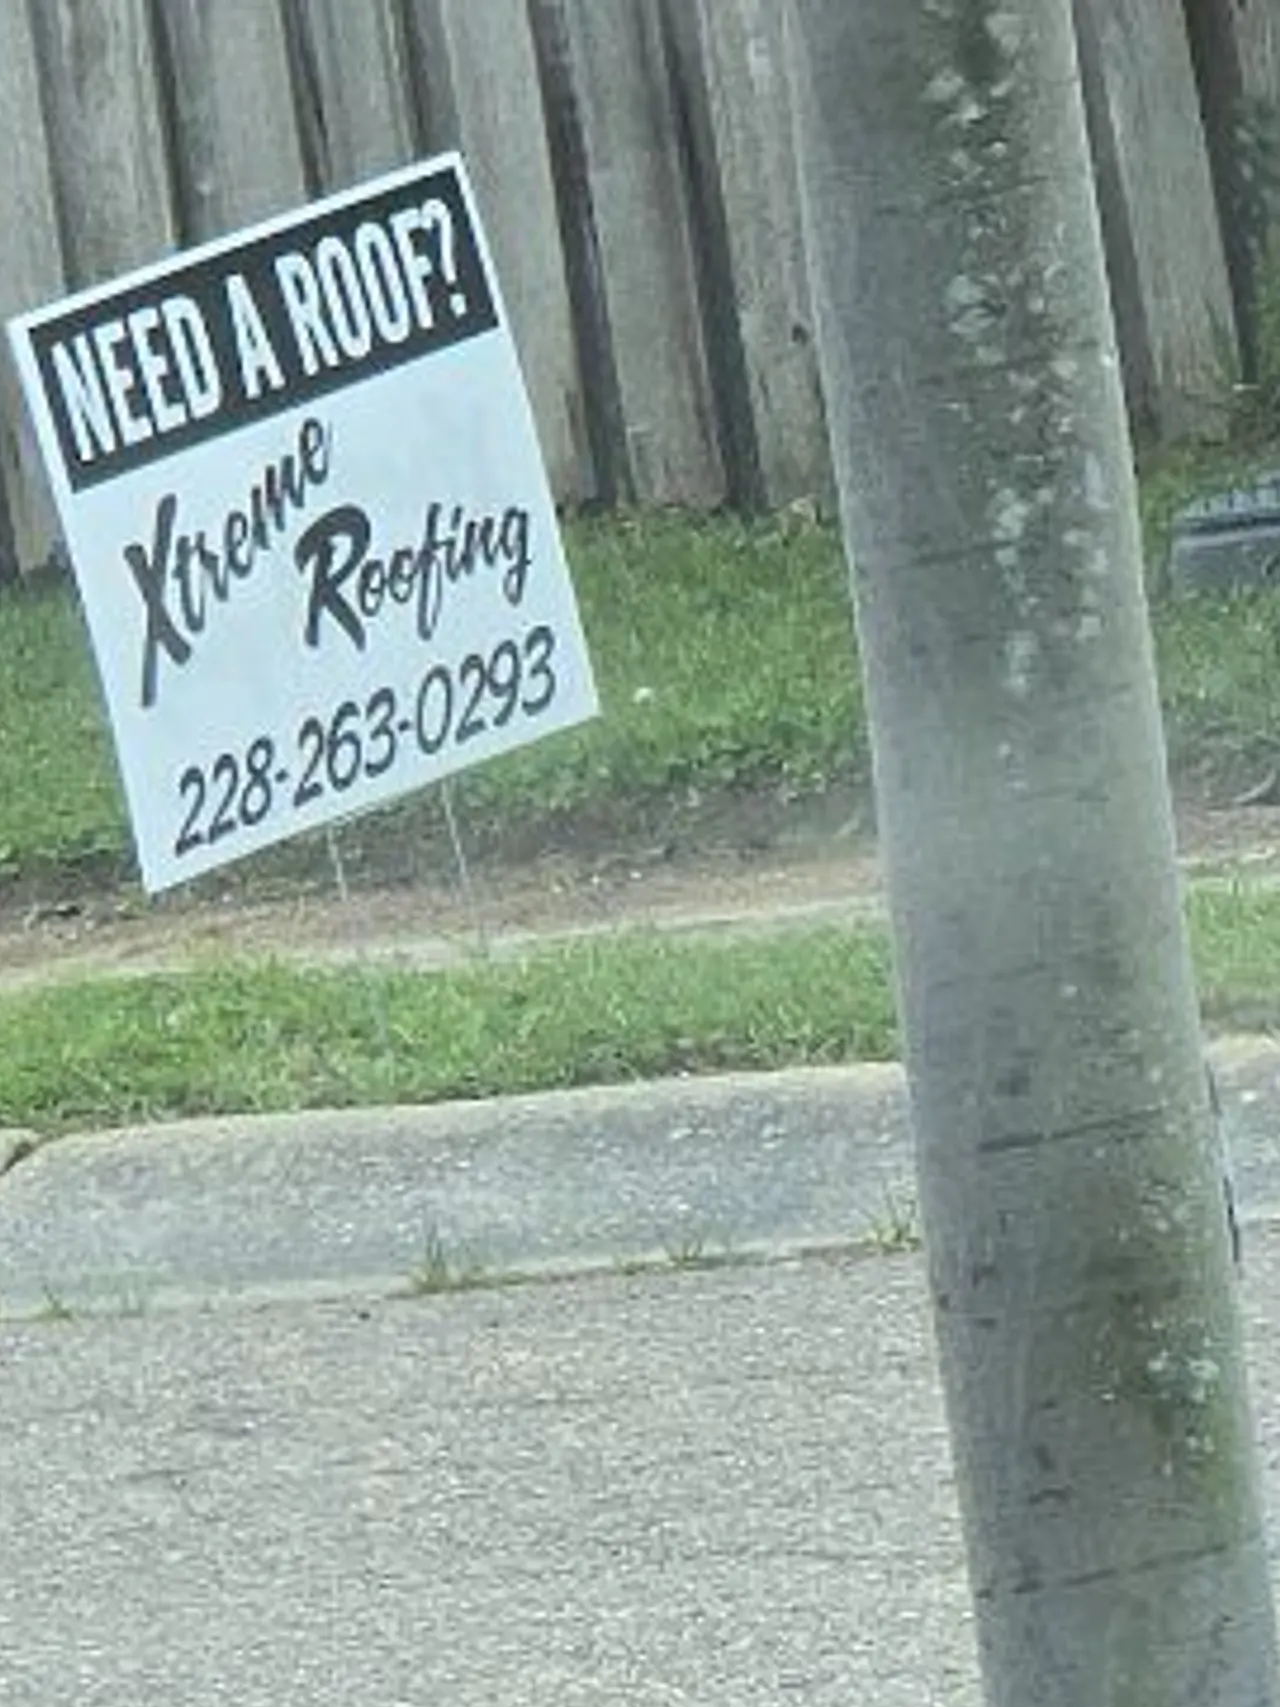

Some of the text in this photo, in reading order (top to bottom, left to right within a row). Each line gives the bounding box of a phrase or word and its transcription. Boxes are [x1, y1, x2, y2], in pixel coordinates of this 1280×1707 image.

[51, 198, 468, 462] NEED A ROOF?
[124, 416, 332, 708] Xtreme
[295, 501, 531, 650] Roofing
[176, 624, 557, 856] 228-263-0293
